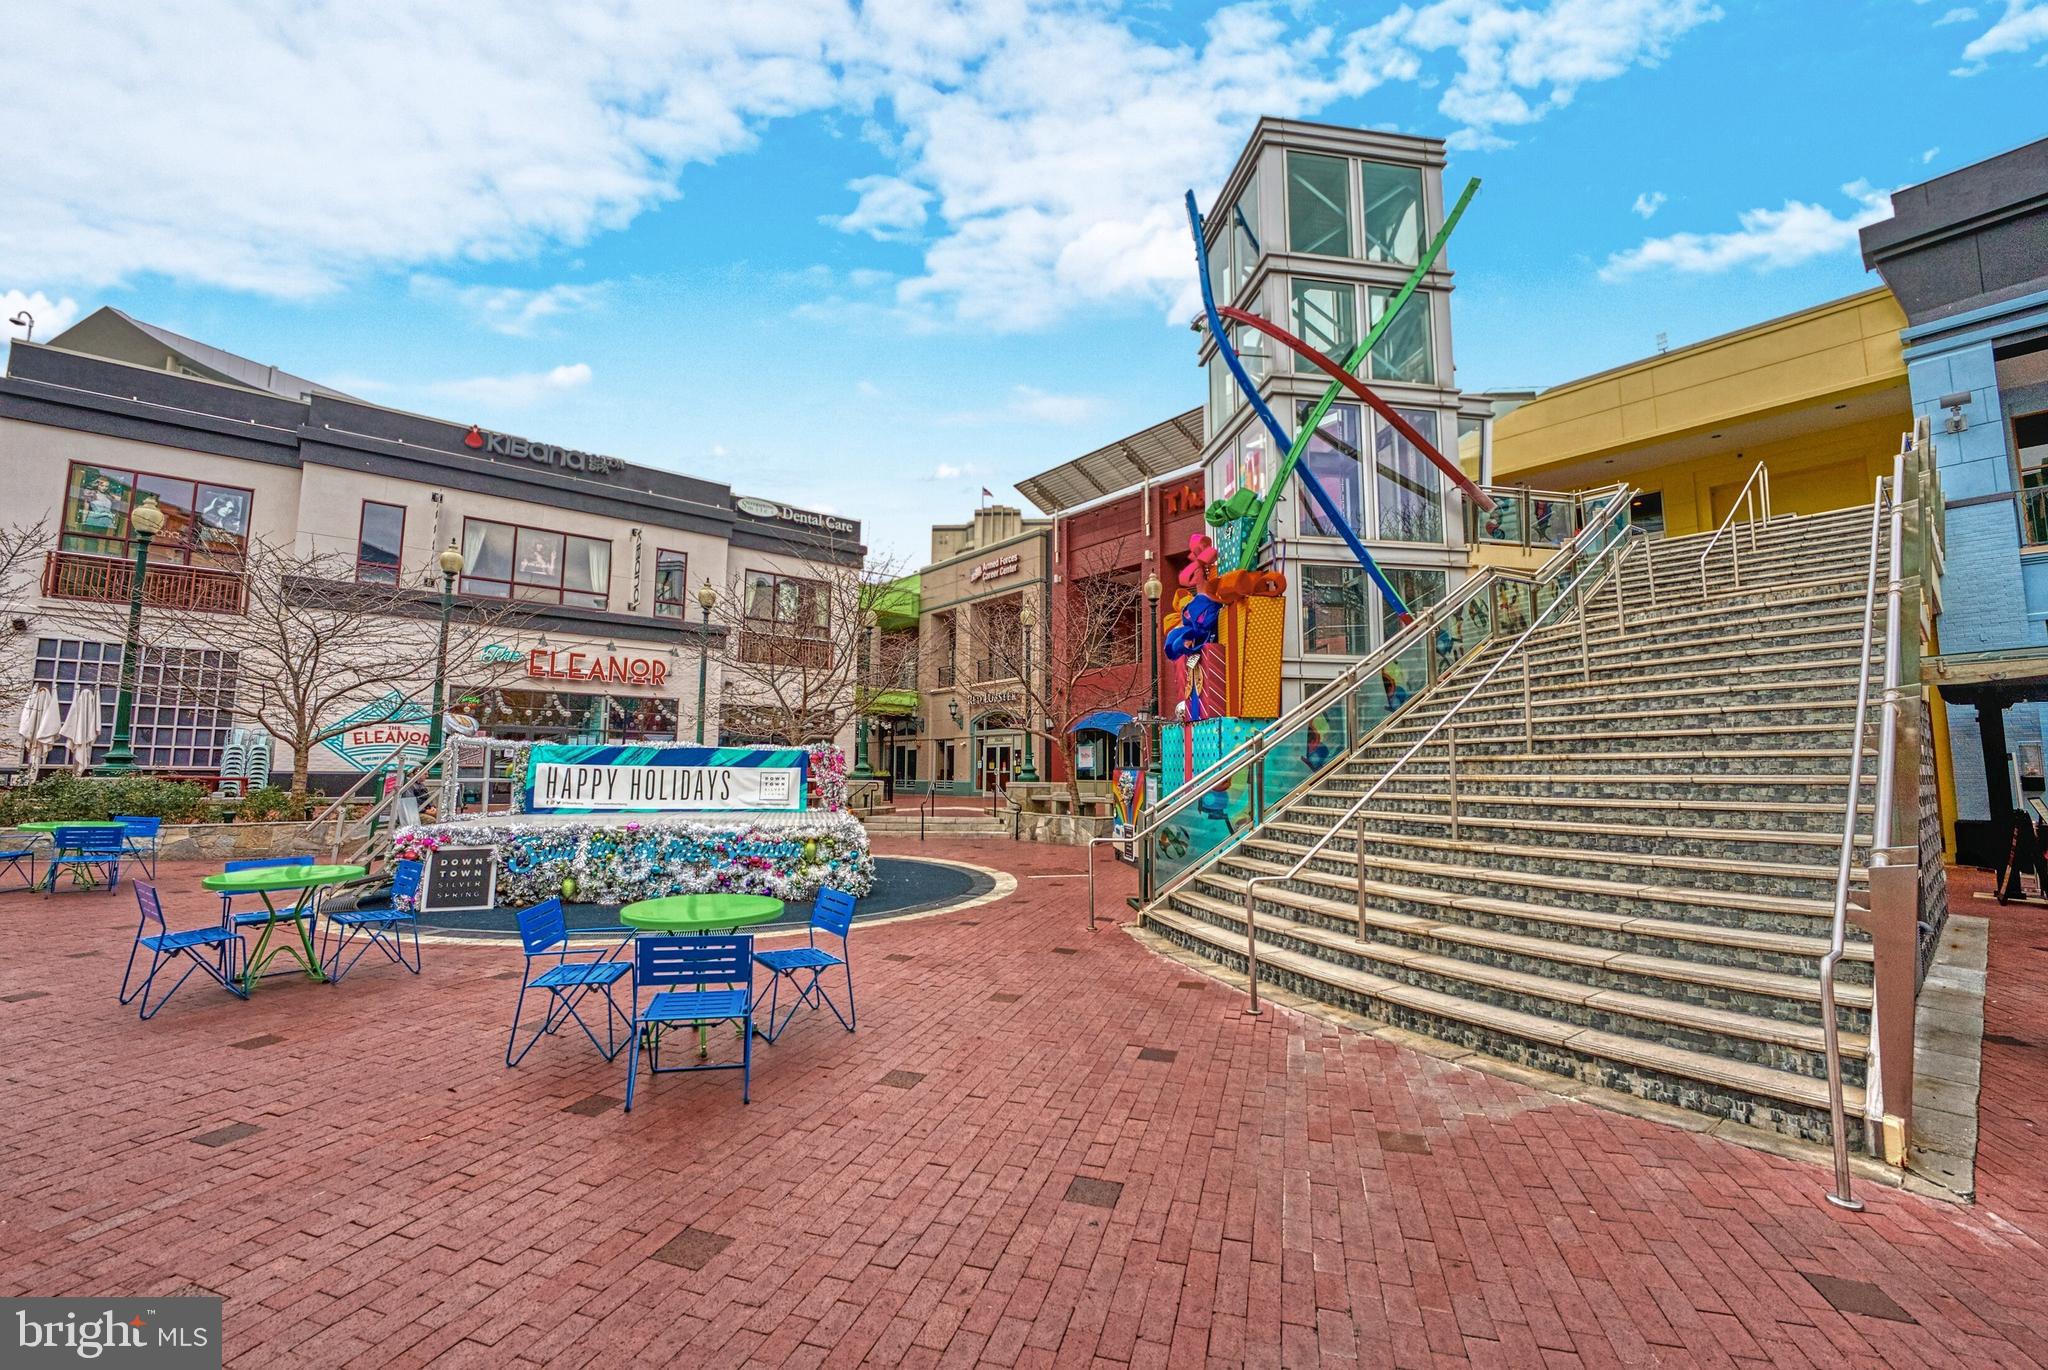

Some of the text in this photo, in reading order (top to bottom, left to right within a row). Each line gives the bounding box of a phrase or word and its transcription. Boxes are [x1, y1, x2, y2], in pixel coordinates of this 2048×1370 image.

[781, 506, 854, 533] Dental Care
[1000, 554, 1018, 566] Forces
[1000, 564, 1018, 576] Center
[480, 642, 667, 686] The ELEANOR
[353, 730, 432, 747] ELEANOR
[546, 766, 731, 801] HAPPY HOLIDAYS
[440, 858, 483, 867] DOWN
[440, 869, 482, 878] TOWN
[438, 881, 481, 889] SILVER
[437, 891, 480, 899] SPRING
